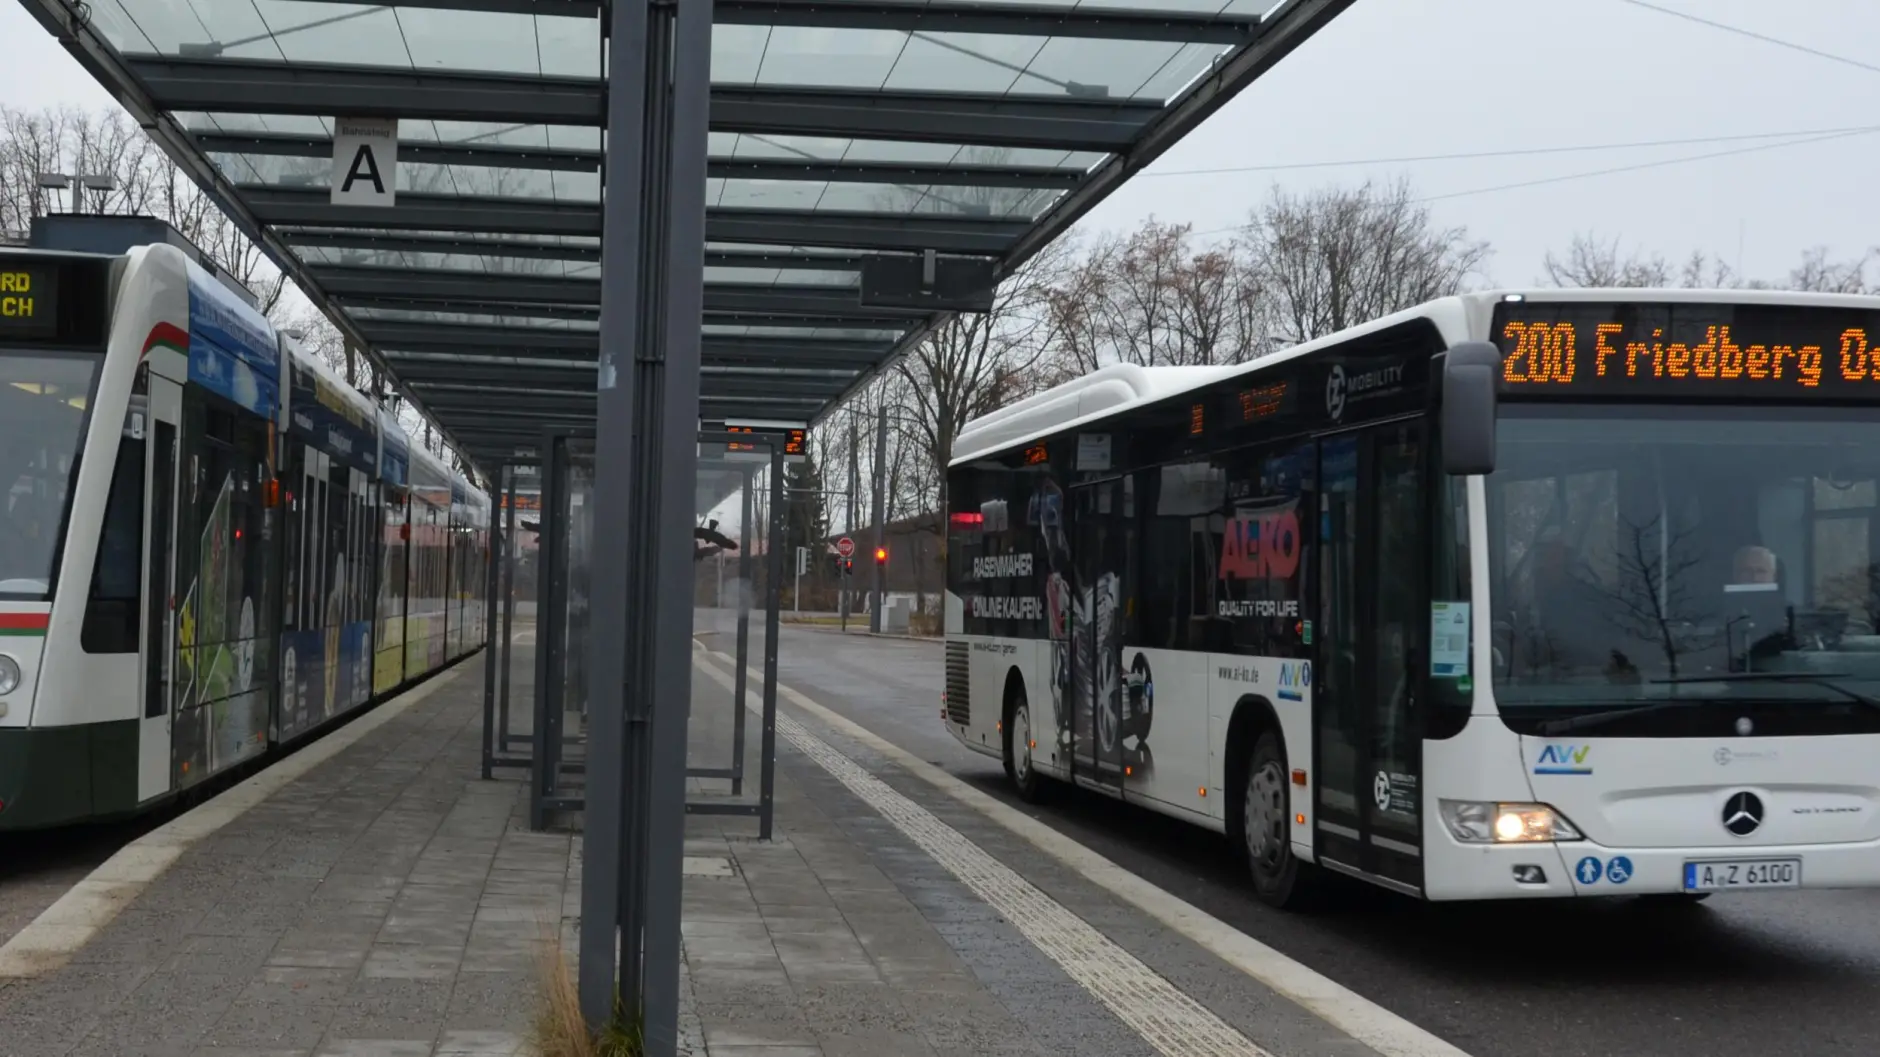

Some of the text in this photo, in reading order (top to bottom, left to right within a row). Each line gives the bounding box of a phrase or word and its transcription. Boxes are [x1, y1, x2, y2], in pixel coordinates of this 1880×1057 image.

[341, 127, 390, 139] Bahnsteig
[340, 144, 386, 194] A
[0, 272, 30, 292] RD
[1503, 321, 1576, 383] 200
[1594, 323, 1822, 386] Friedberg
[1346, 363, 1404, 393] MOBILITY
[973, 546, 1033, 578] RASENMÄHER
[973, 597, 1002, 618] ONLINE
[1219, 600, 1298, 617] QUALITY FOR LIFE
[1703, 864, 1793, 885] A Z 6100
